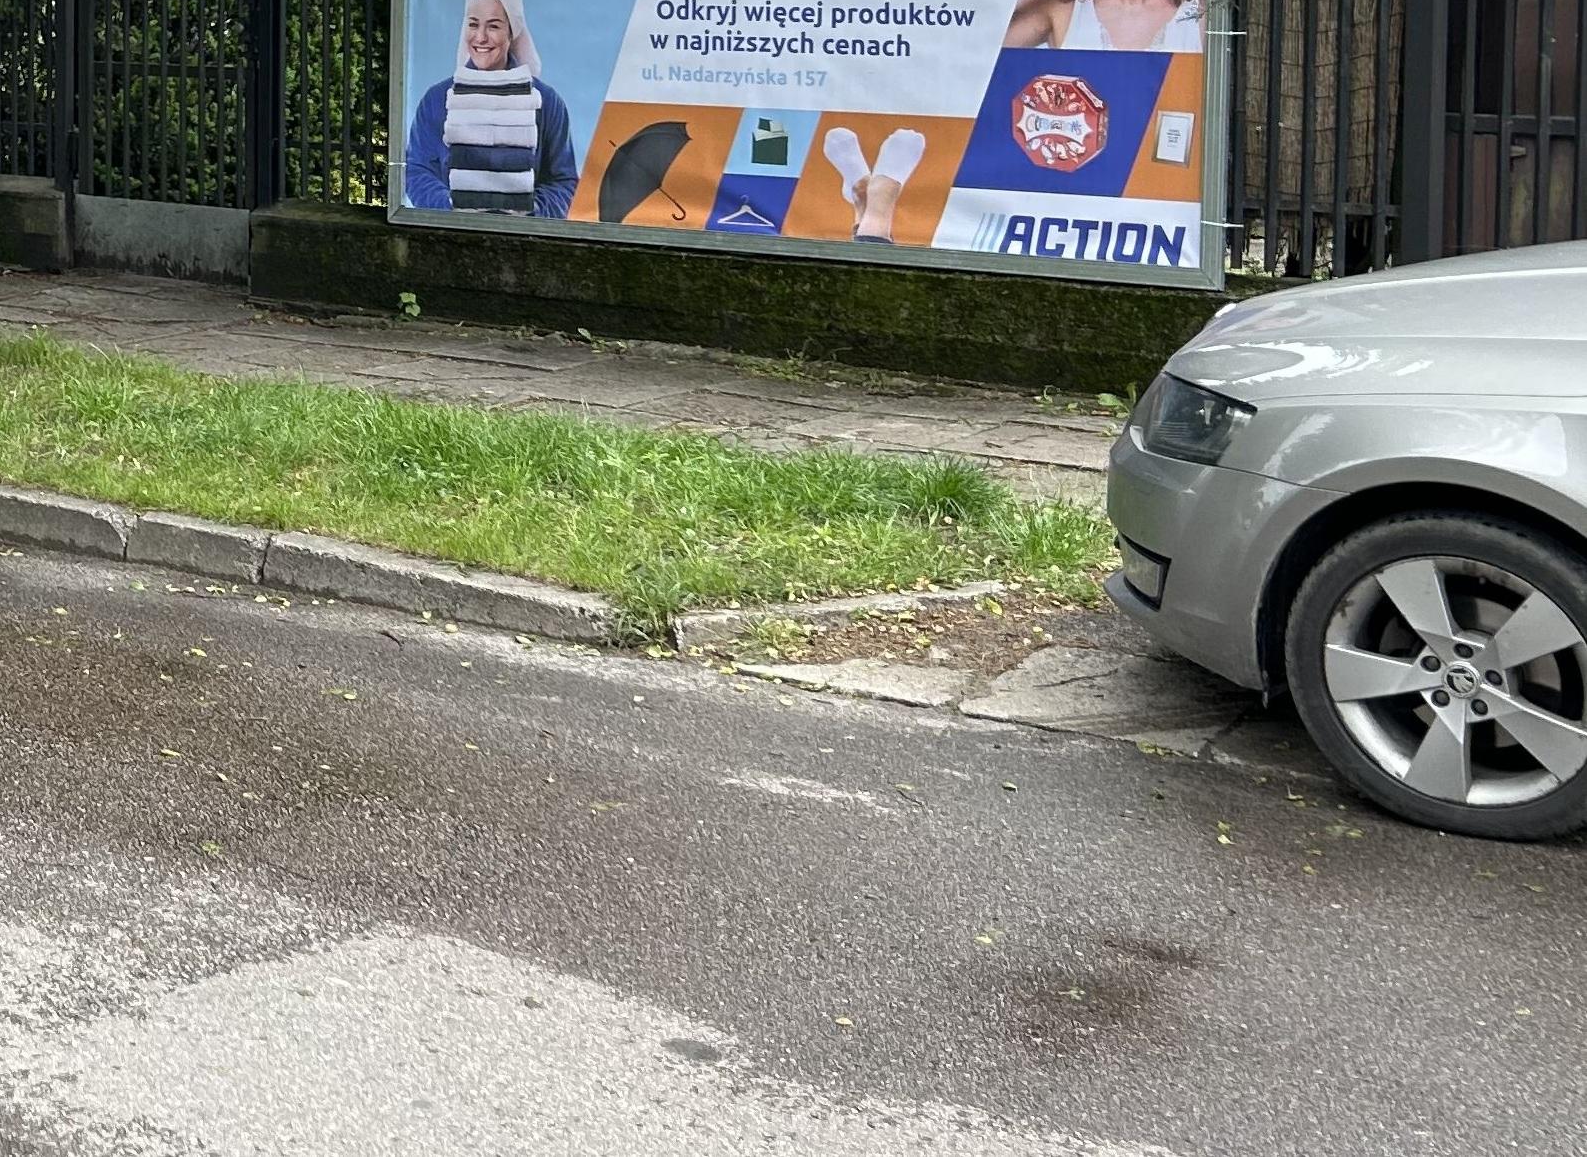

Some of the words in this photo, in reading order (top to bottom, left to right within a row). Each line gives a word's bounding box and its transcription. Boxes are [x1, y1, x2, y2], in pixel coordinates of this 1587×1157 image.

[744, 0, 823, 29] więcej
[832, 1, 976, 29] produktów
[649, 33, 669, 50] w
[676, 29, 814, 58] najniższych
[822, 33, 911, 57] cenach
[641, 64, 664, 82] ul.
[668, 65, 788, 88] Nadarzyńska
[793, 69, 828, 88] 157
[999, 214, 1187, 267] ACTION
